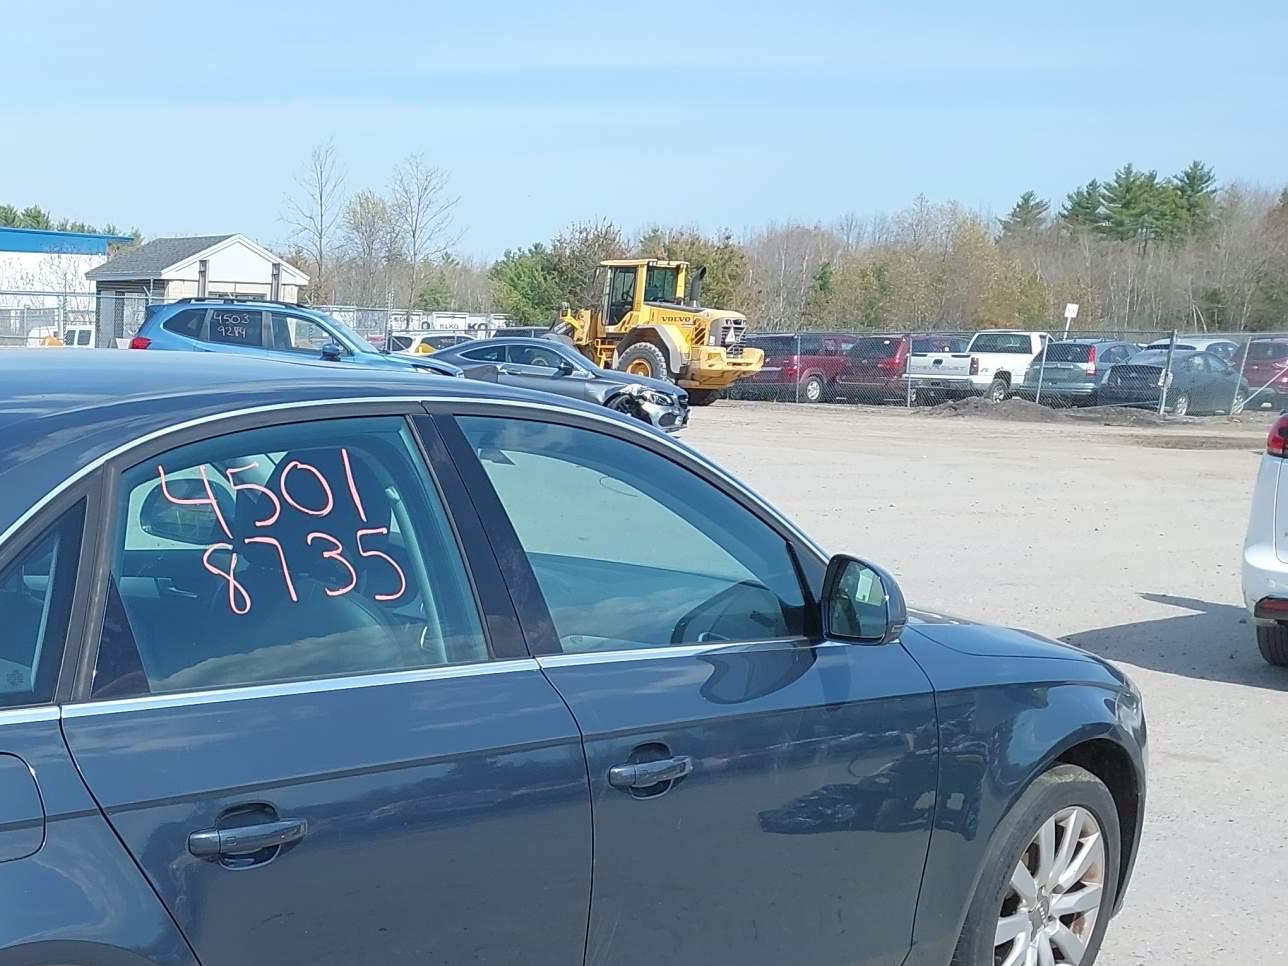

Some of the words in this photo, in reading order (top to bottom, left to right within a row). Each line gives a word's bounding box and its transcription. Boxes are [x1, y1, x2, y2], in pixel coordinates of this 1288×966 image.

[214, 311, 250, 324] 4503
[158, 448, 368, 540] 4501
[202, 527, 408, 615] 8735
